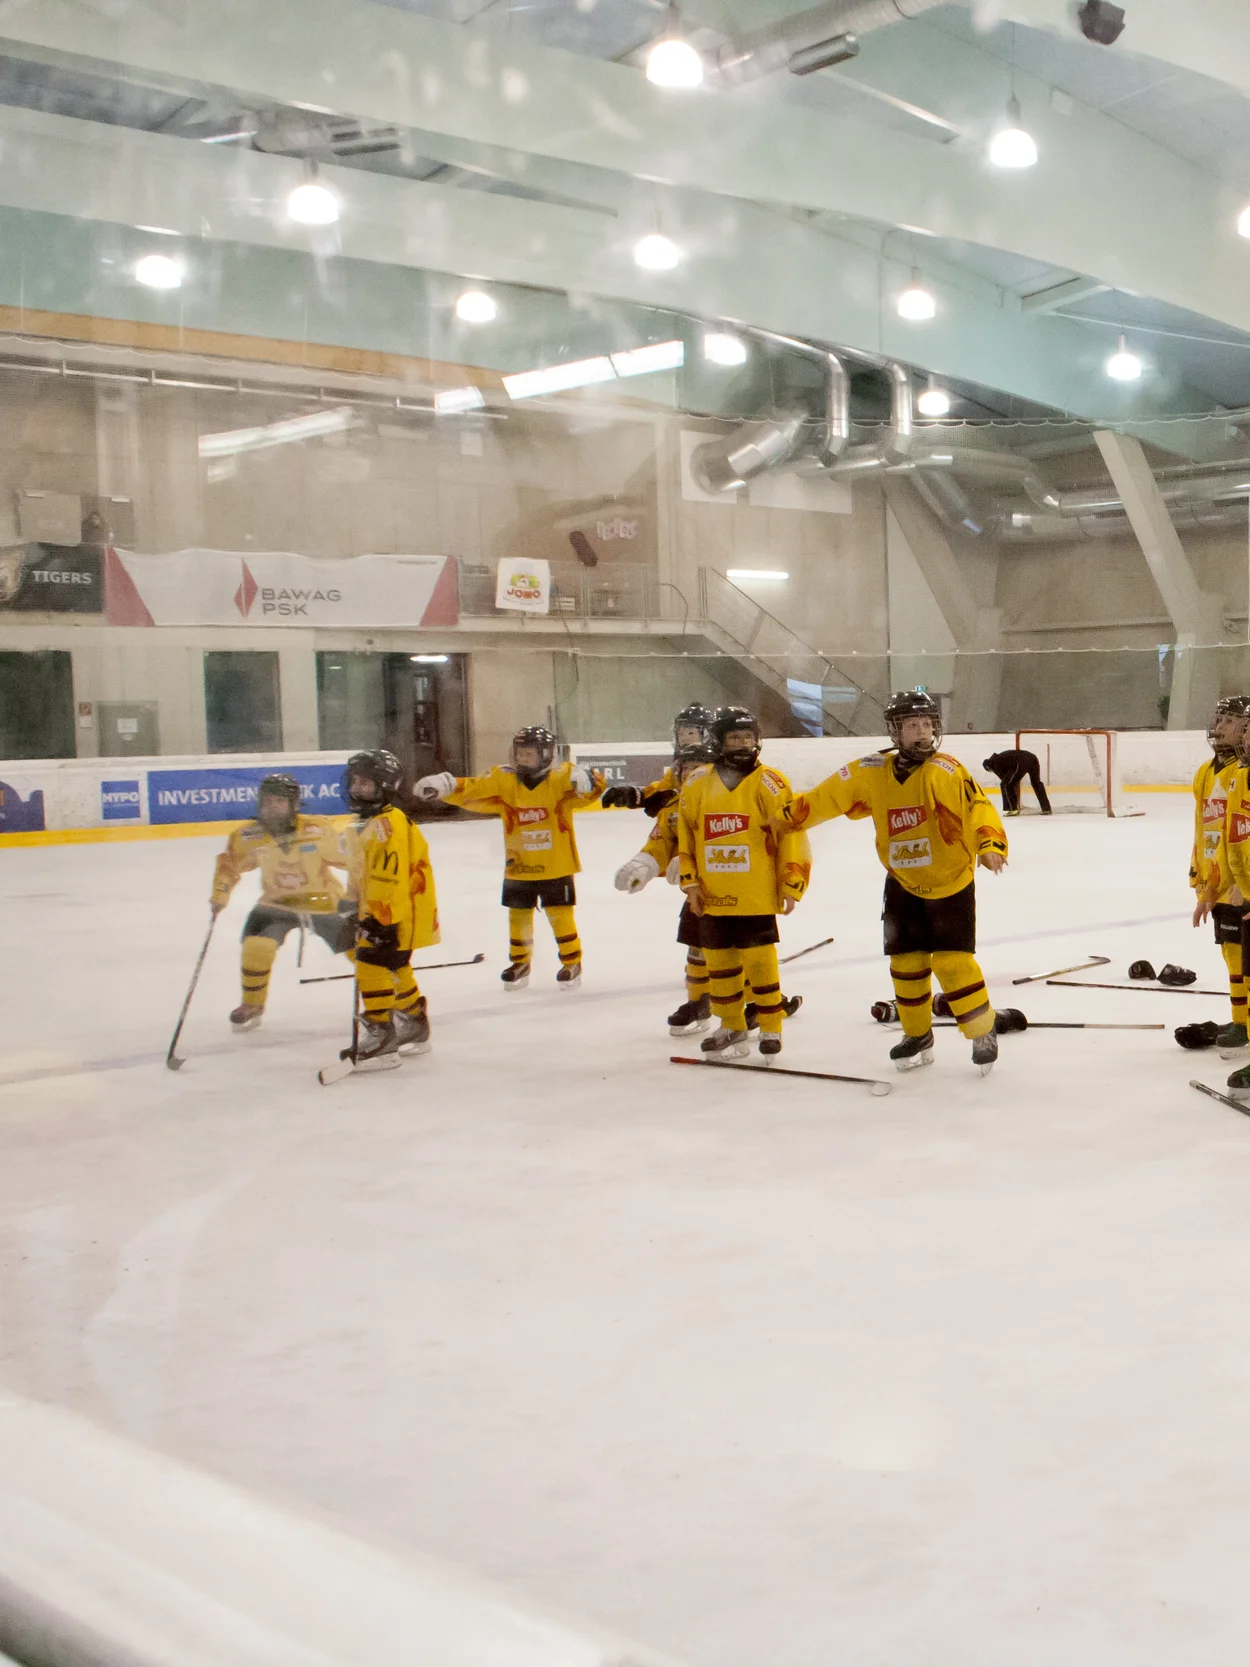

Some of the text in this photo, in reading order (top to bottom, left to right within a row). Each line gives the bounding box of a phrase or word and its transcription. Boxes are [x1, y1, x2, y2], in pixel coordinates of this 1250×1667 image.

[32, 569, 93, 584] TIGERS
[261, 587, 342, 602] BAWAG
[262, 602, 309, 616] PSK
[709, 815, 743, 834] Kelly's
